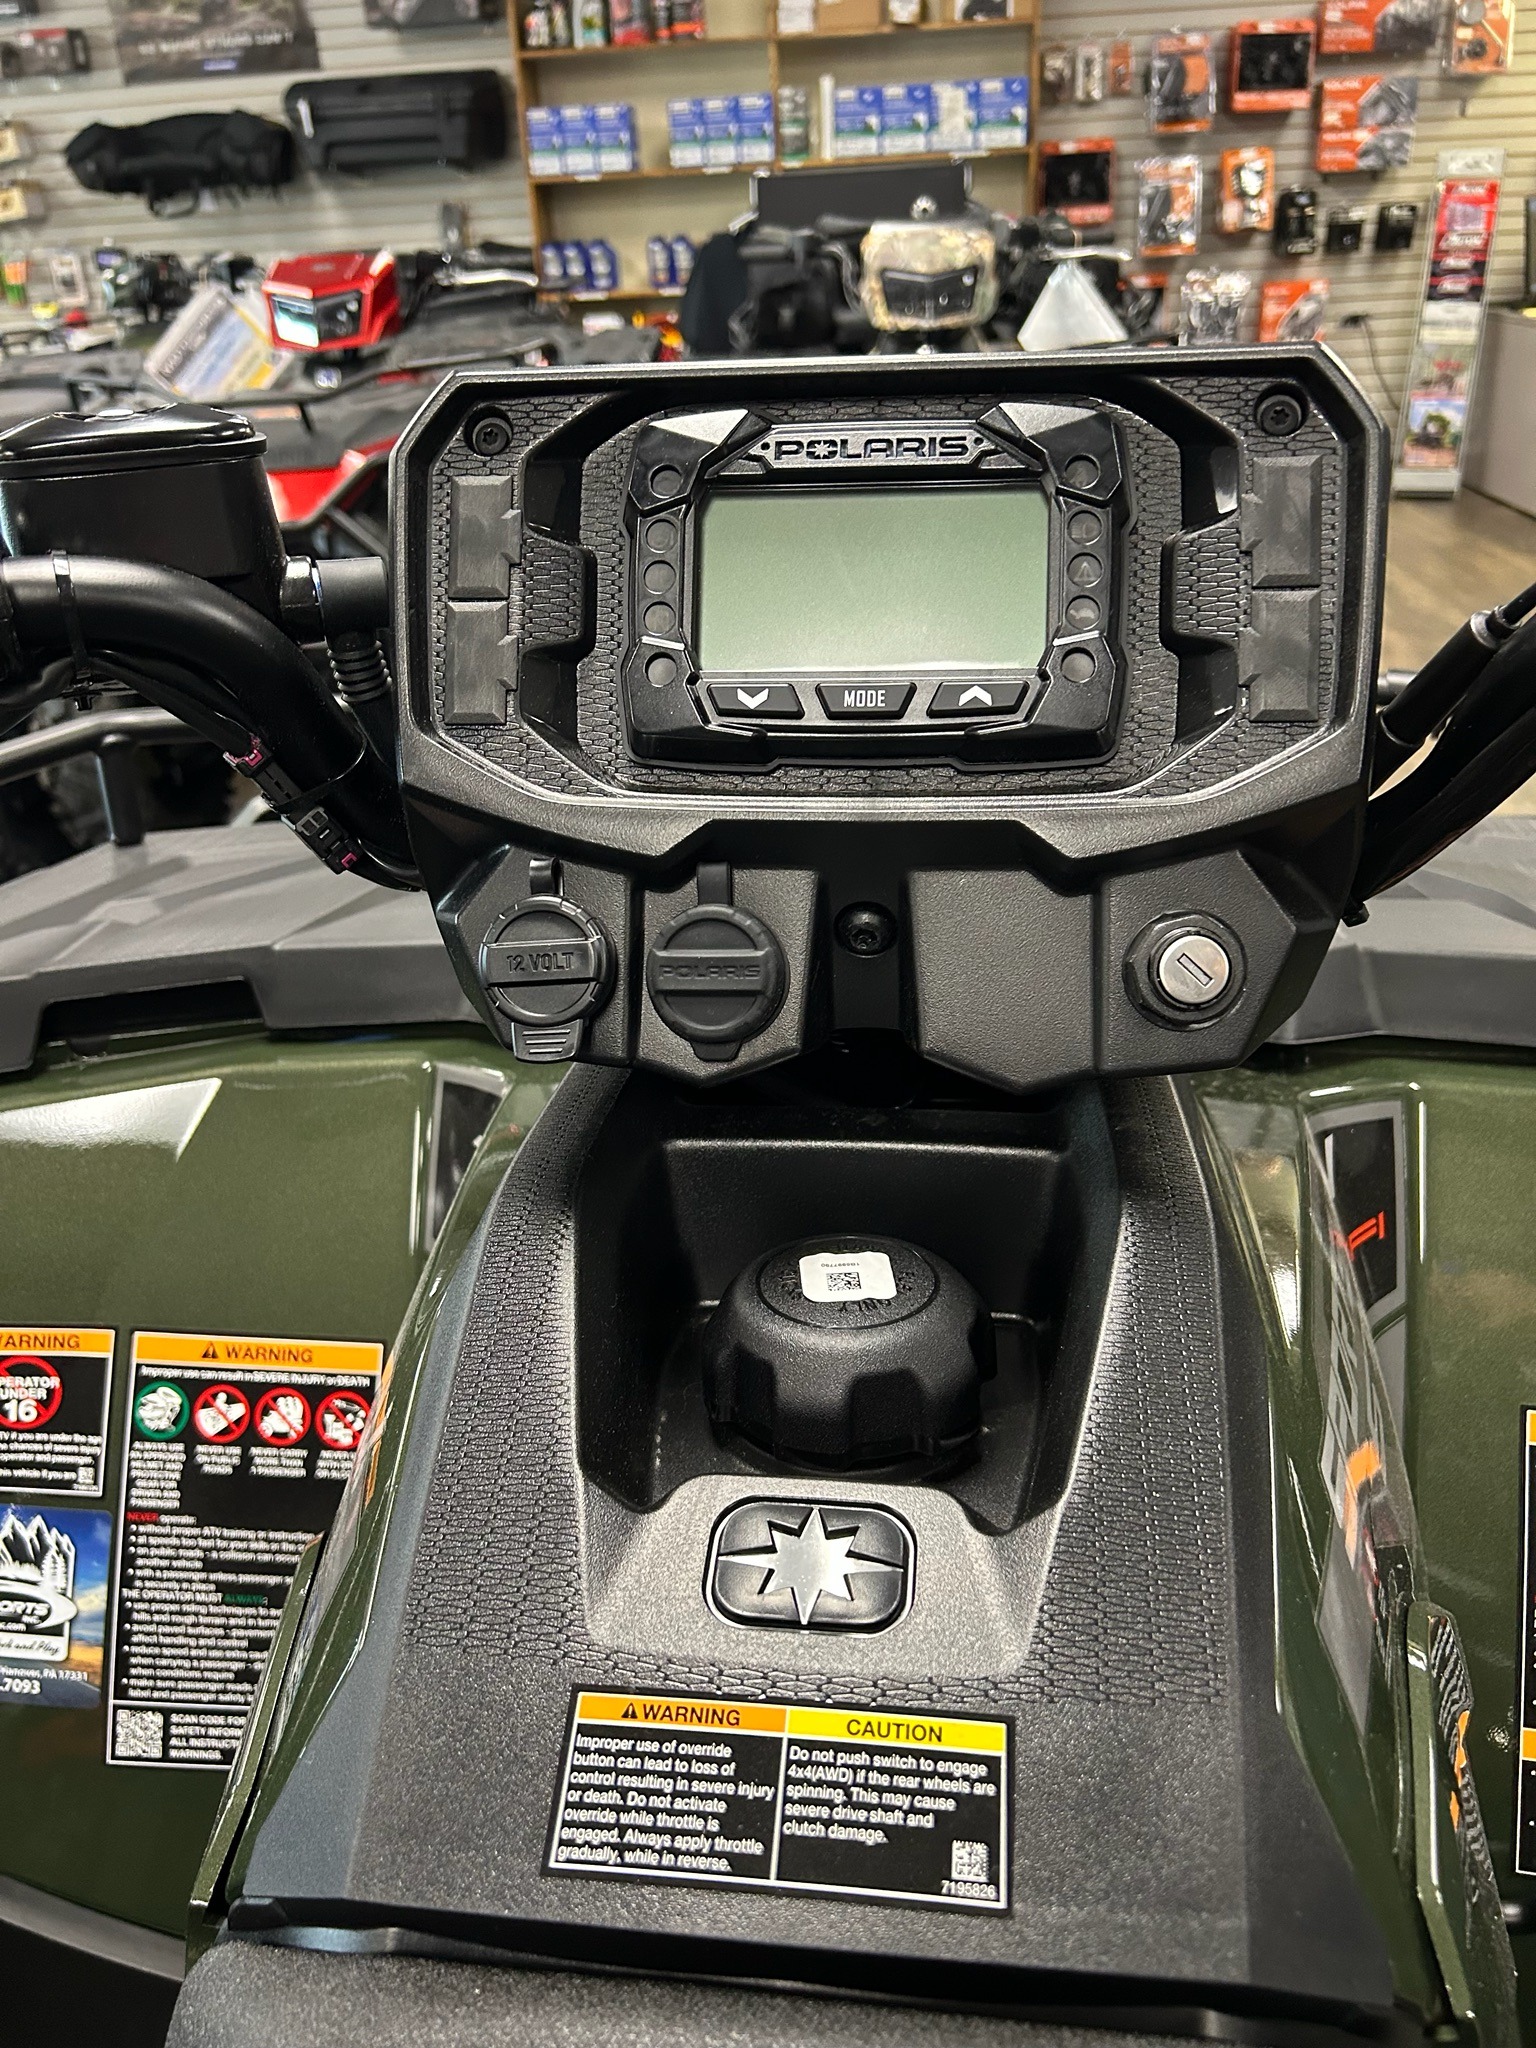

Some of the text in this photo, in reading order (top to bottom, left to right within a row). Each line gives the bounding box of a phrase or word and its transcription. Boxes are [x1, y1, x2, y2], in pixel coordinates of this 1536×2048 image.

[774, 436, 969, 461] POLARIS
[844, 689, 886, 708] MODE
[506, 951, 575, 973] 12 VOLT
[659, 964, 761, 980] POLARIS
[0, 1334, 80, 1349] ARNING
[225, 1344, 313, 1363] WARNING
[0, 1376, 60, 1388] PERATOR
[0, 1387, 47, 1400] UNDER
[3, 1399, 38, 1423] 16
[126, 1511, 158, 1522] NEVER
[122, 1588, 141, 1600] THE
[141, 1589, 194, 1602] OPERATOR
[194, 1592, 224, 1604] MUST
[0, 1600, 50, 1617] ORTS
[43, 1668, 58, 1680] PA
[58, 1670, 89, 1682] 17331
[170, 1713, 198, 1725] SCAN
[198, 1714, 226, 1727] CODE
[643, 1703, 740, 1726] WARNING
[170, 1724, 207, 1738] SAFETY
[846, 1719, 942, 1742] CAUTION
[169, 1736, 188, 1749] ALL
[576, 1732, 732, 1758] Improper use of override
[573, 1750, 736, 1776] button can lead to loss of
[789, 1745, 988, 1779] Do not push switch to engage
[570, 1770, 775, 1801] control resulting in severe injury
[787, 1764, 998, 1796] 4x4(AWD) if the rear wheels are
[567, 1788, 728, 1814] or death. Do not activate
[786, 1783, 957, 1812] spinning. This may cause
[564, 1806, 720, 1832] override while throttle is
[784, 1802, 936, 1828] severe drive shaft and
[560, 1826, 765, 1855] engaged. Always apply throttle
[782, 1820, 889, 1846] clutch damage.
[557, 1844, 732, 1872] gradually, while in reverse.
[941, 1880, 998, 1900] 7195826
